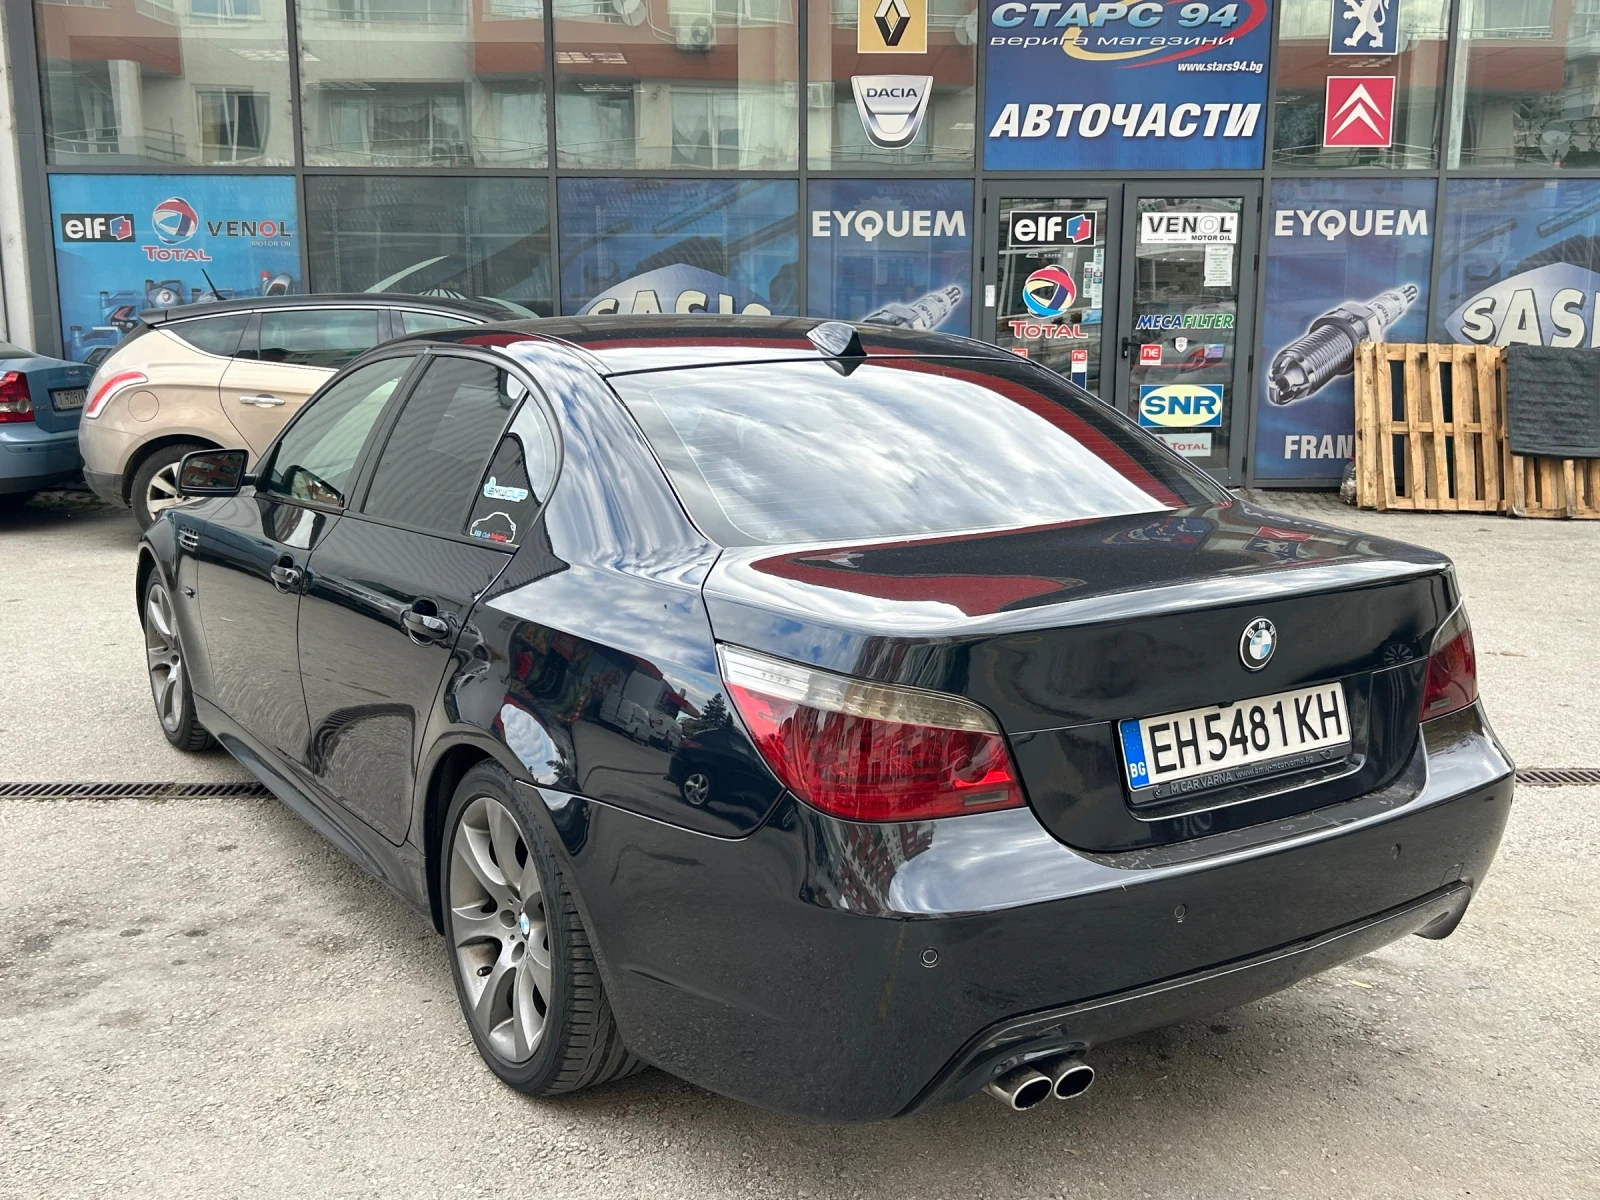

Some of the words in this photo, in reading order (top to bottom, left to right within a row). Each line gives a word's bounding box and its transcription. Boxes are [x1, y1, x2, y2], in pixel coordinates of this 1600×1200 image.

[991, 2, 1164, 28] СТАРС
[1178, 2, 1239, 28] 94
[990, 36, 1089, 49] верига
[1097, 36, 1235, 47] магазини
[1178, 61, 1263, 74] www.stars94.bg
[866, 88, 918, 98] DACIA
[989, 103, 1261, 138] АВТОЧАСТИ
[65, 217, 106, 238] elf
[206, 220, 293, 238] VENOL
[812, 210, 966, 241] EYQUEM
[1014, 217, 1062, 242] elf
[1147, 215, 1233, 234] VENOL
[1274, 209, 1428, 241] EYQUEM
[1136, 314, 1234, 330] MECAFILTER
[1145, 396, 1217, 415] SNR
[1284, 434, 1354, 459] FRAN
[1130, 762, 1147, 778] BG
[1170, 784, 1180, 795] M
[1181, 778, 1199, 792] CAR
[1201, 771, 1233, 788] VARNA
